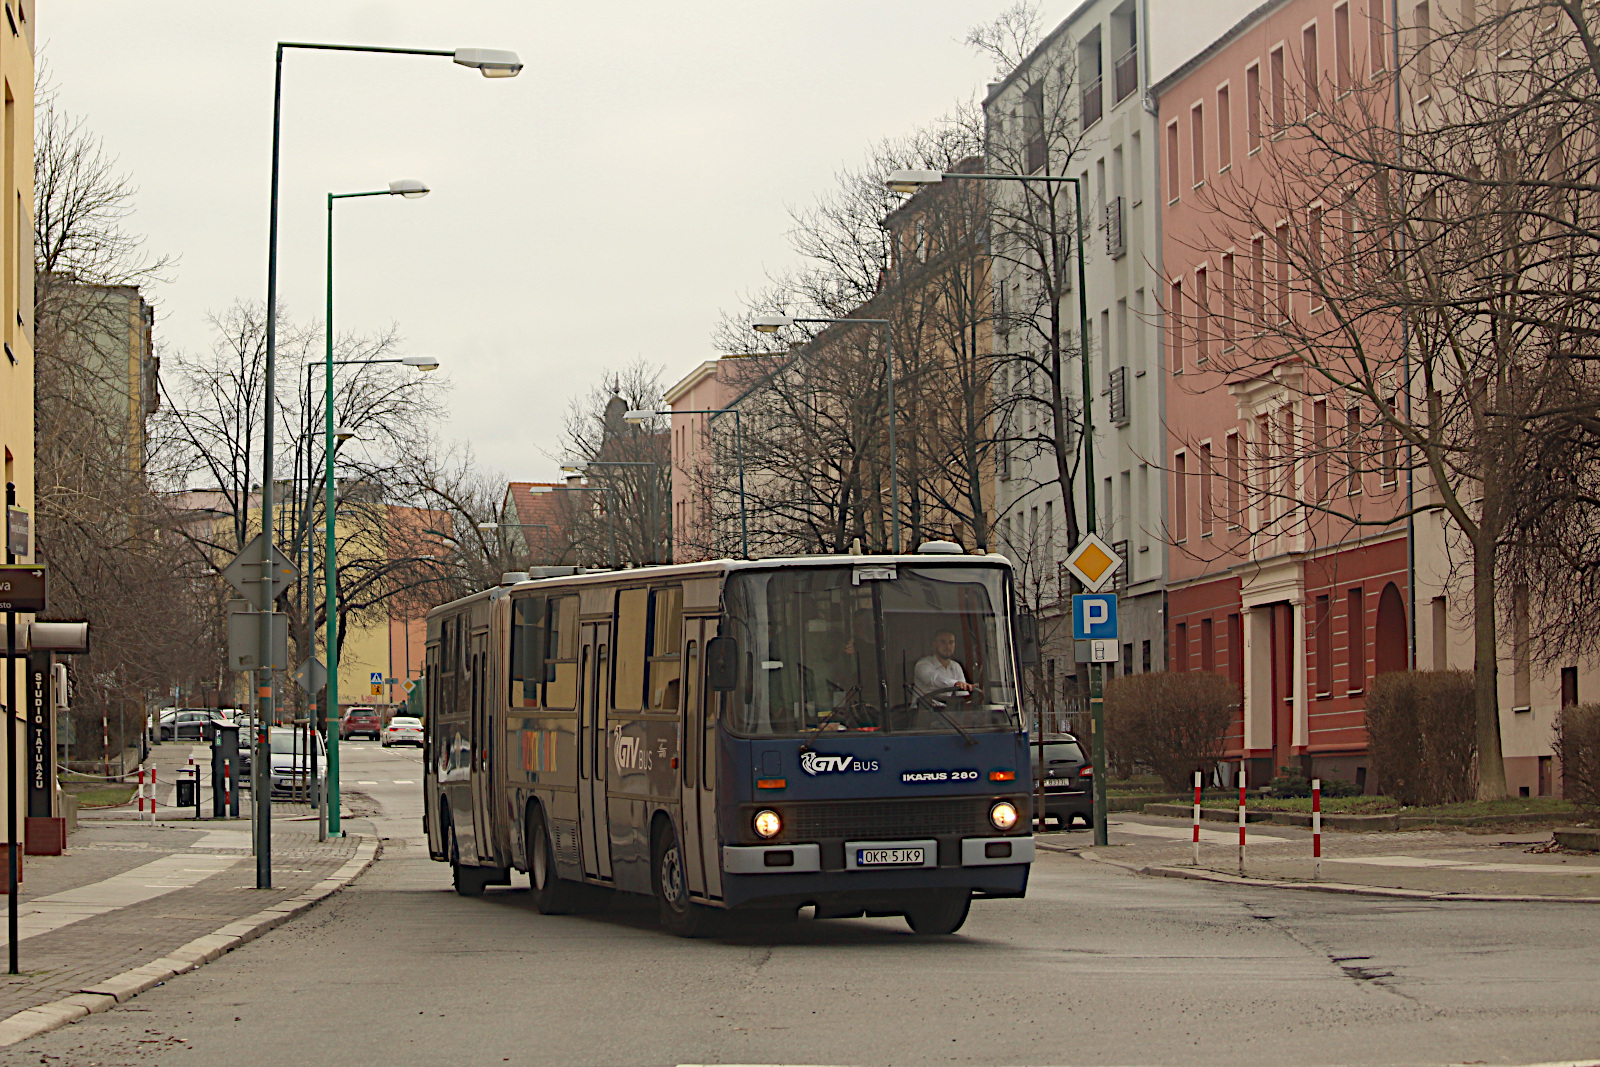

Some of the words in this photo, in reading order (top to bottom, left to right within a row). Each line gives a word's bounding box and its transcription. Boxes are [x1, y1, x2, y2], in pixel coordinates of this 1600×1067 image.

[1083, 599, 1108, 634] P
[35, 672, 43, 724] STUDIO
[35, 728, 43, 789] TATUAŻU
[620, 736, 640, 769] GTV
[638, 749, 653, 771] BUS
[811, 756, 854, 772] GTV
[853, 760, 879, 771] BUS
[902, 772, 948, 782] IKARUS
[951, 771, 978, 780] 280
[865, 850, 888, 863] OKR
[892, 850, 921, 862] 5JK9
